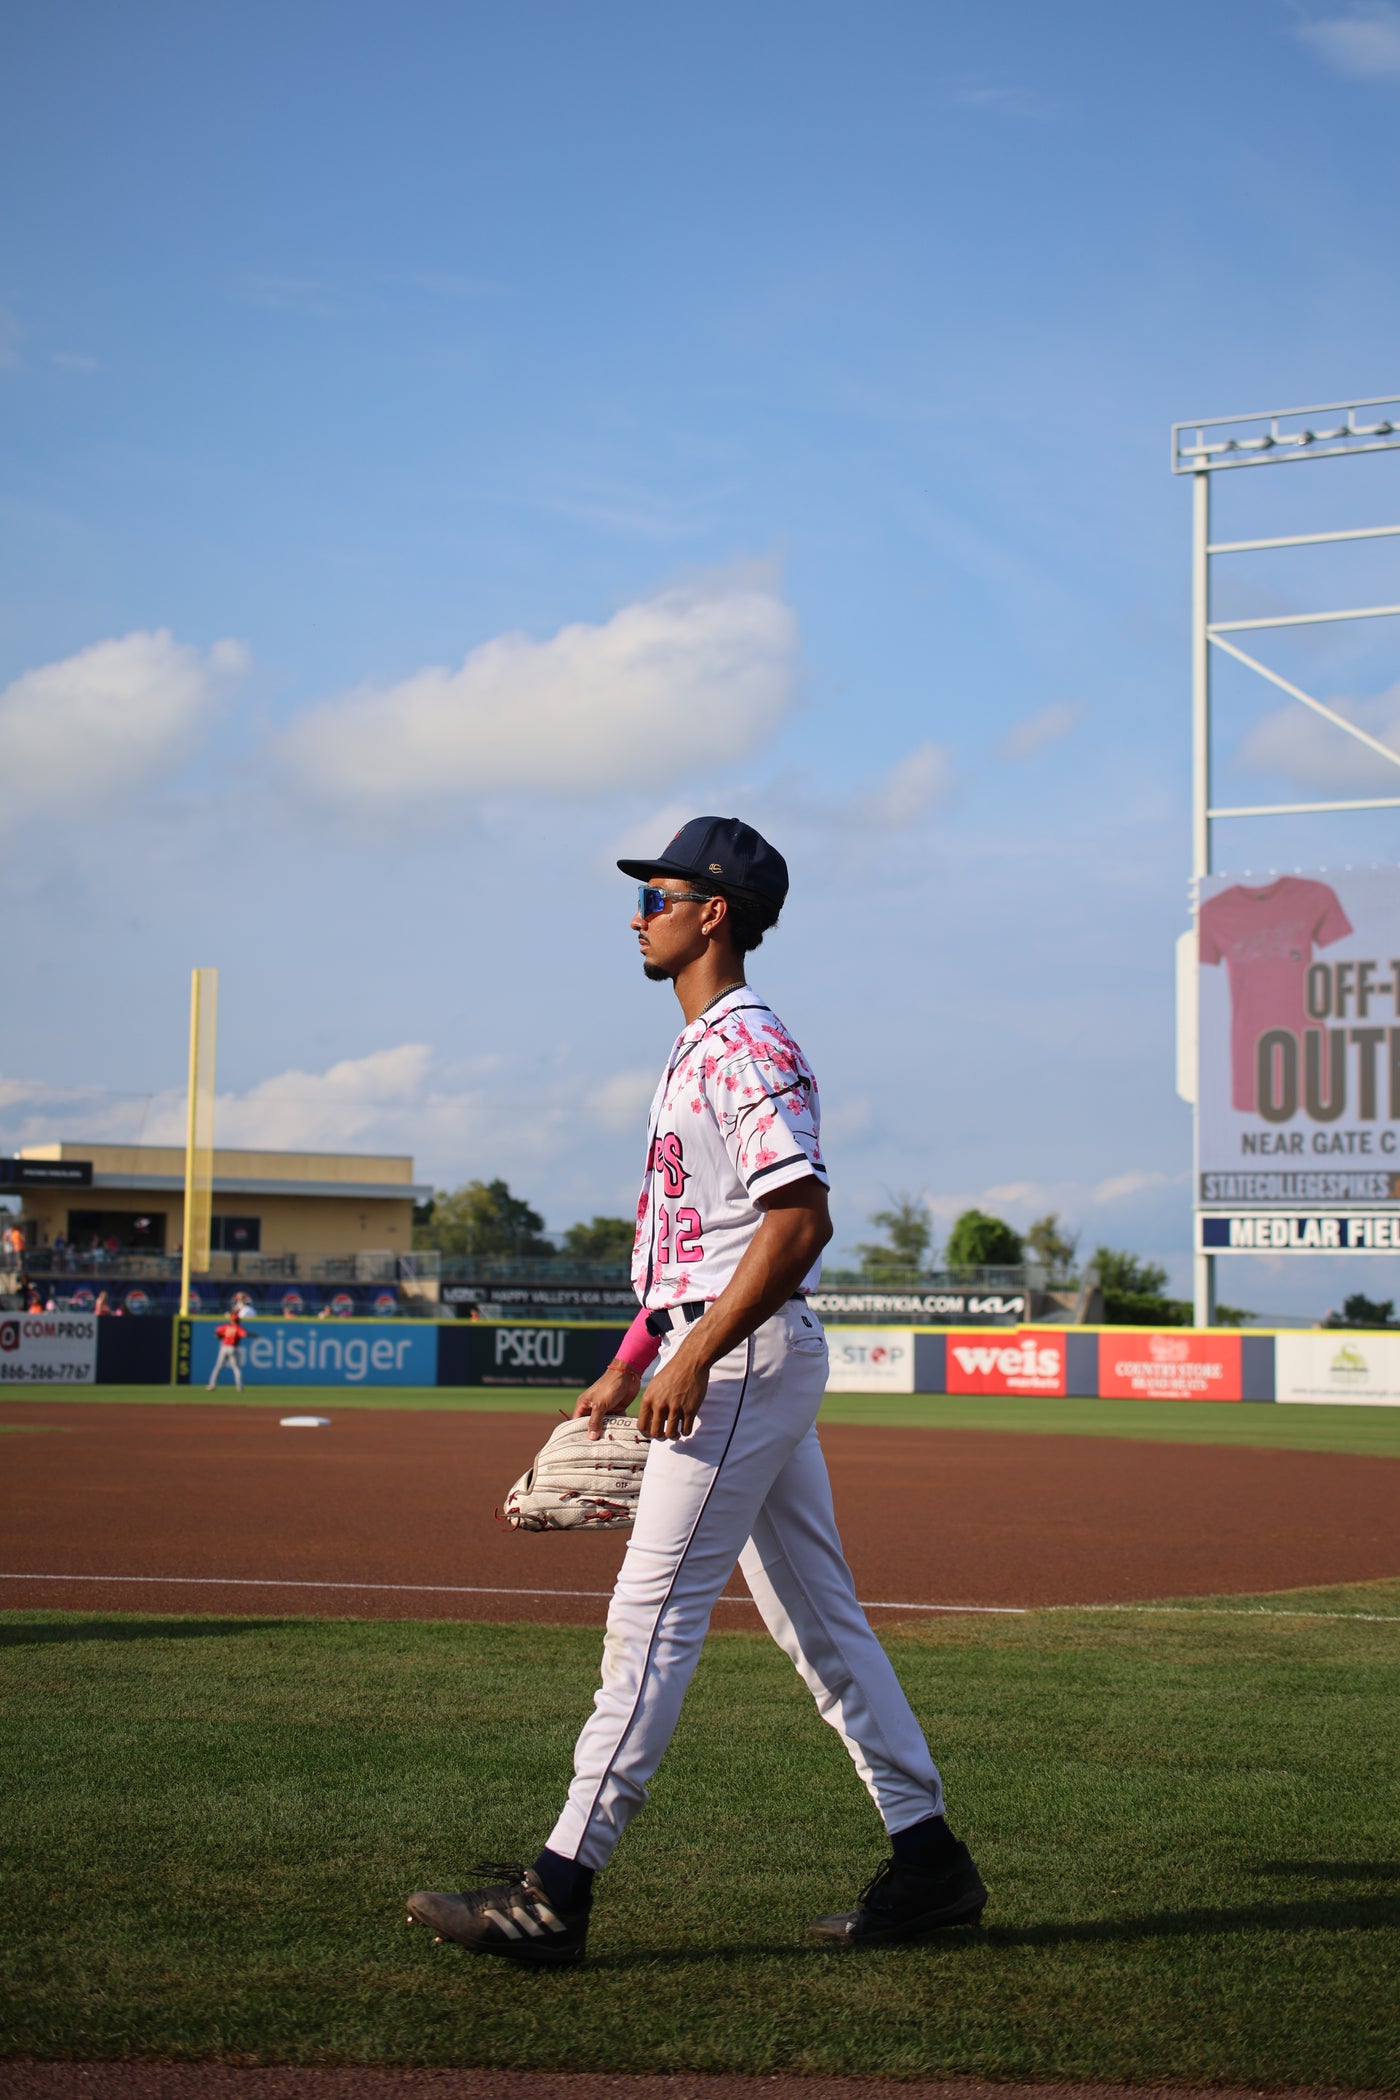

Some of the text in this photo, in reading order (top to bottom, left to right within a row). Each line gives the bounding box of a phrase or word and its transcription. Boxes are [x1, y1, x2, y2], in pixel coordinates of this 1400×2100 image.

[1257, 1028, 1400, 1123] OUT
[1241, 1130, 1396, 1155] NEAR GATE C
[658, 1204, 704, 1263] 22
[1230, 1218, 1340, 1247] MEDLAR
[23, 1322, 93, 1339] COMPROS
[495, 1328, 565, 1366] PSECU
[952, 1340, 1060, 1376] weis
